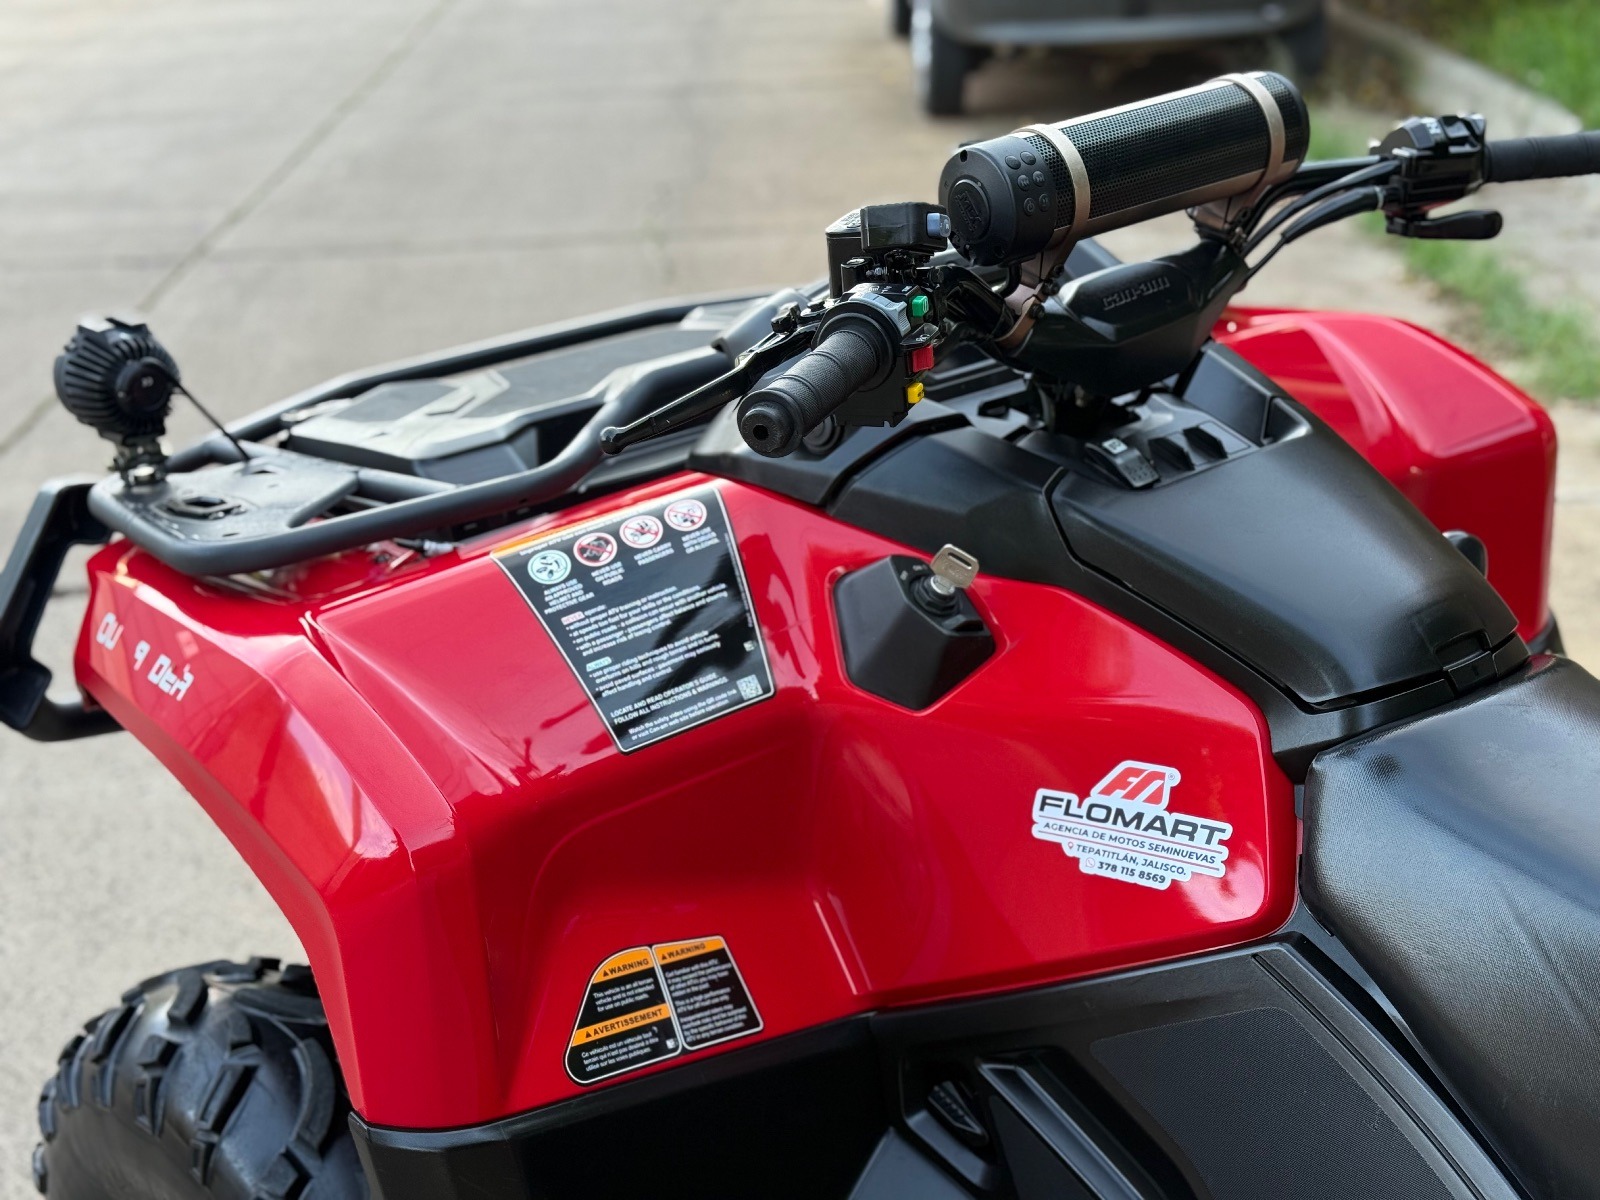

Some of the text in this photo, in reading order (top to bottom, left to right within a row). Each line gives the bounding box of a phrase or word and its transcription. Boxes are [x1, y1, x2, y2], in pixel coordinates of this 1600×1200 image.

[610, 705, 634, 718] LOCATE
[633, 700, 647, 709] AND
[646, 694, 663, 704] READ
[615, 712, 639, 724] FOLLOW
[639, 707, 650, 715] ALL
[650, 691, 692, 711] INSTRUCTIONS
[1039, 795, 1227, 846] FLOMART
[1043, 822, 1217, 864] AGENCIA DE MOTOS SEMINUEVAS
[1076, 844, 1187, 876] TEPATITLÁN, JALISCO.
[1097, 861, 1166, 884] 378 115 8569
[667, 943, 706, 959] WARNING
[609, 958, 649, 975] WARNING
[591, 1009, 664, 1036] AVERTISSEMENT
